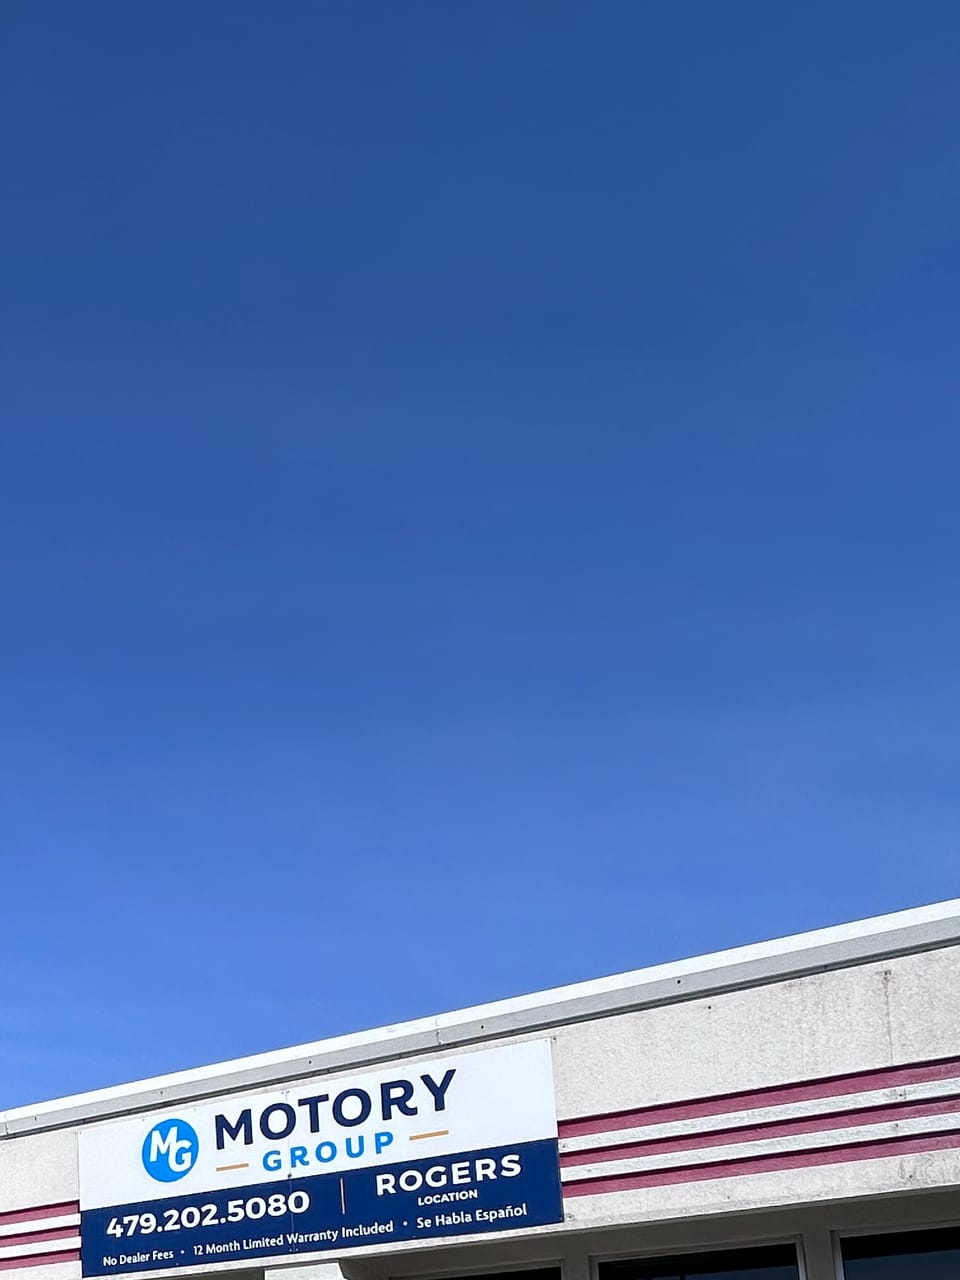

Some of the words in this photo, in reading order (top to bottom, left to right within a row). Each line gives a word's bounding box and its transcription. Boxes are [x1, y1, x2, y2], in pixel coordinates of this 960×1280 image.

[215, 1068, 457, 1151] MOTORY
[149, 1126, 193, 1172] MG
[262, 1131, 395, 1172] GROUP
[376, 1154, 522, 1197] ROGERS
[417, 1189, 478, 1207] LOCATION
[102, 1256, 118, 1267] No
[119, 1251, 150, 1264] Dealer
[152, 1249, 175, 1261] Fees
[193, 1245, 204, 1256] 12
[205, 1240, 241, 1255] Month
[242, 1235, 284, 1250] Limited
[286, 1229, 339, 1245] Warranty
[341, 1220, 394, 1238] Included
[416, 1217, 432, 1229] Se
[435, 1210, 473, 1227] Habla
[476, 1203, 528, 1222] Español
[106, 1190, 310, 1239] 479.202.5080
